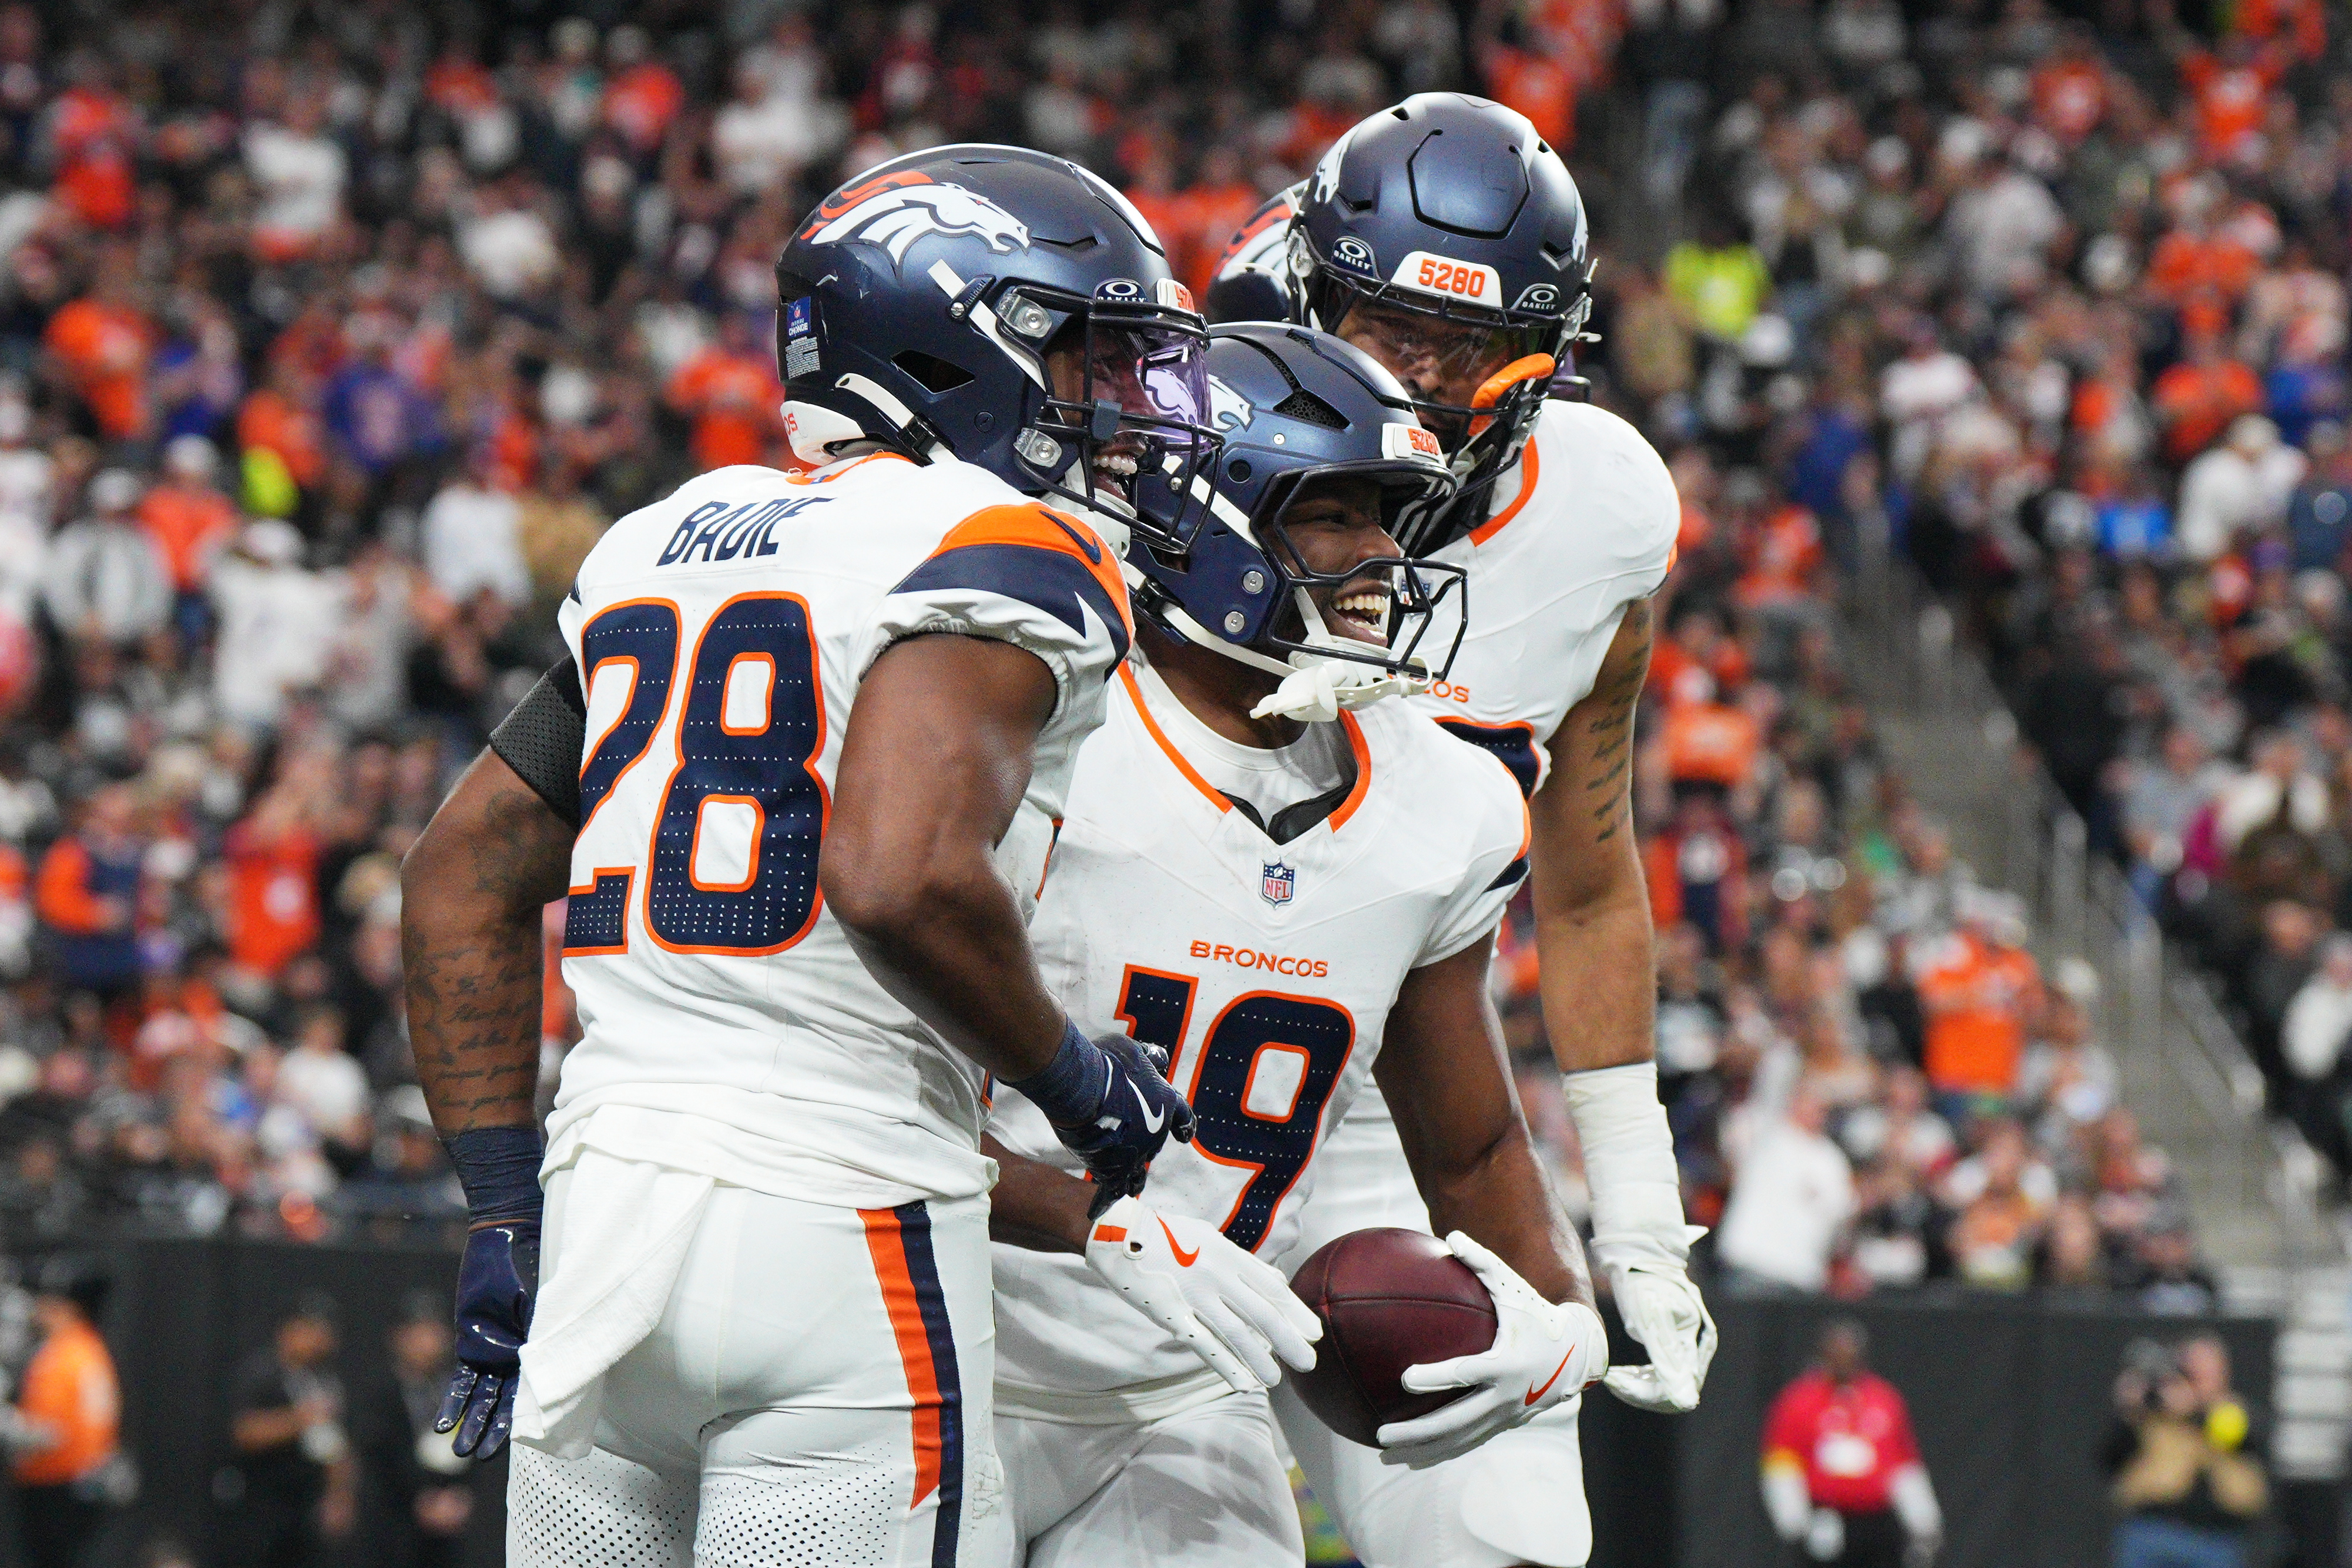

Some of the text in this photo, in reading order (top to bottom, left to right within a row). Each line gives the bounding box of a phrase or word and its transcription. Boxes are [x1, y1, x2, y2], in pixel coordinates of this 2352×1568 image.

[1334, 250, 1370, 270] OAKLEY
[1418, 258, 1485, 297] 5280
[656, 497, 837, 566] BADIE
[562, 590, 833, 957] 28
[1264, 878, 1290, 899] NFL
[1190, 940, 1328, 977] BRONCOS
